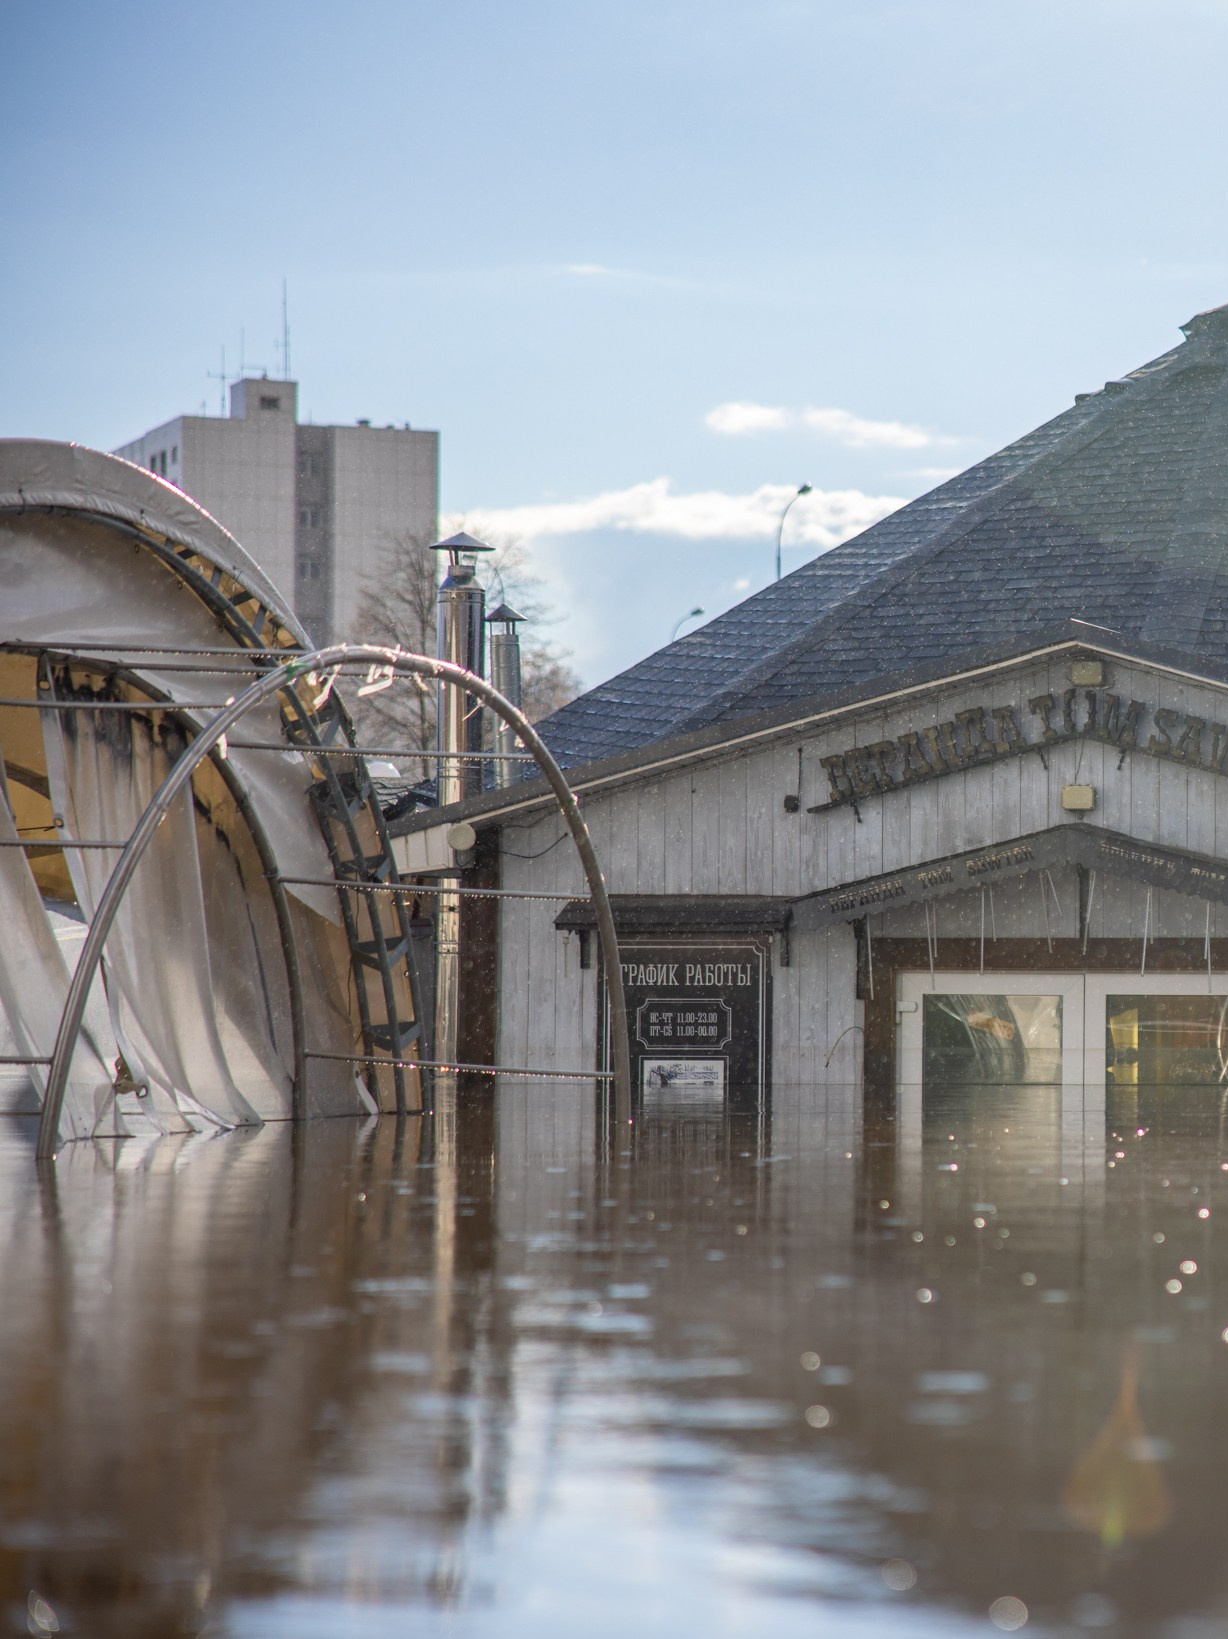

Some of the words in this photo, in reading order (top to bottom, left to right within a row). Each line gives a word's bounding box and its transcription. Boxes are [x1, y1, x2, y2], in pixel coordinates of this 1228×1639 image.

[1029, 688, 1145, 747] TOM
[620, 964, 679, 986] ГРАФИК
[685, 964, 752, 986] РАБОТЫ
[650, 1013, 673, 1024] ВС-ЧТ
[677, 1013, 718, 1024] 11.00-23.00
[650, 1026, 672, 1037] ПТ-СБ
[677, 1026, 718, 1037] 11.00-00.00
